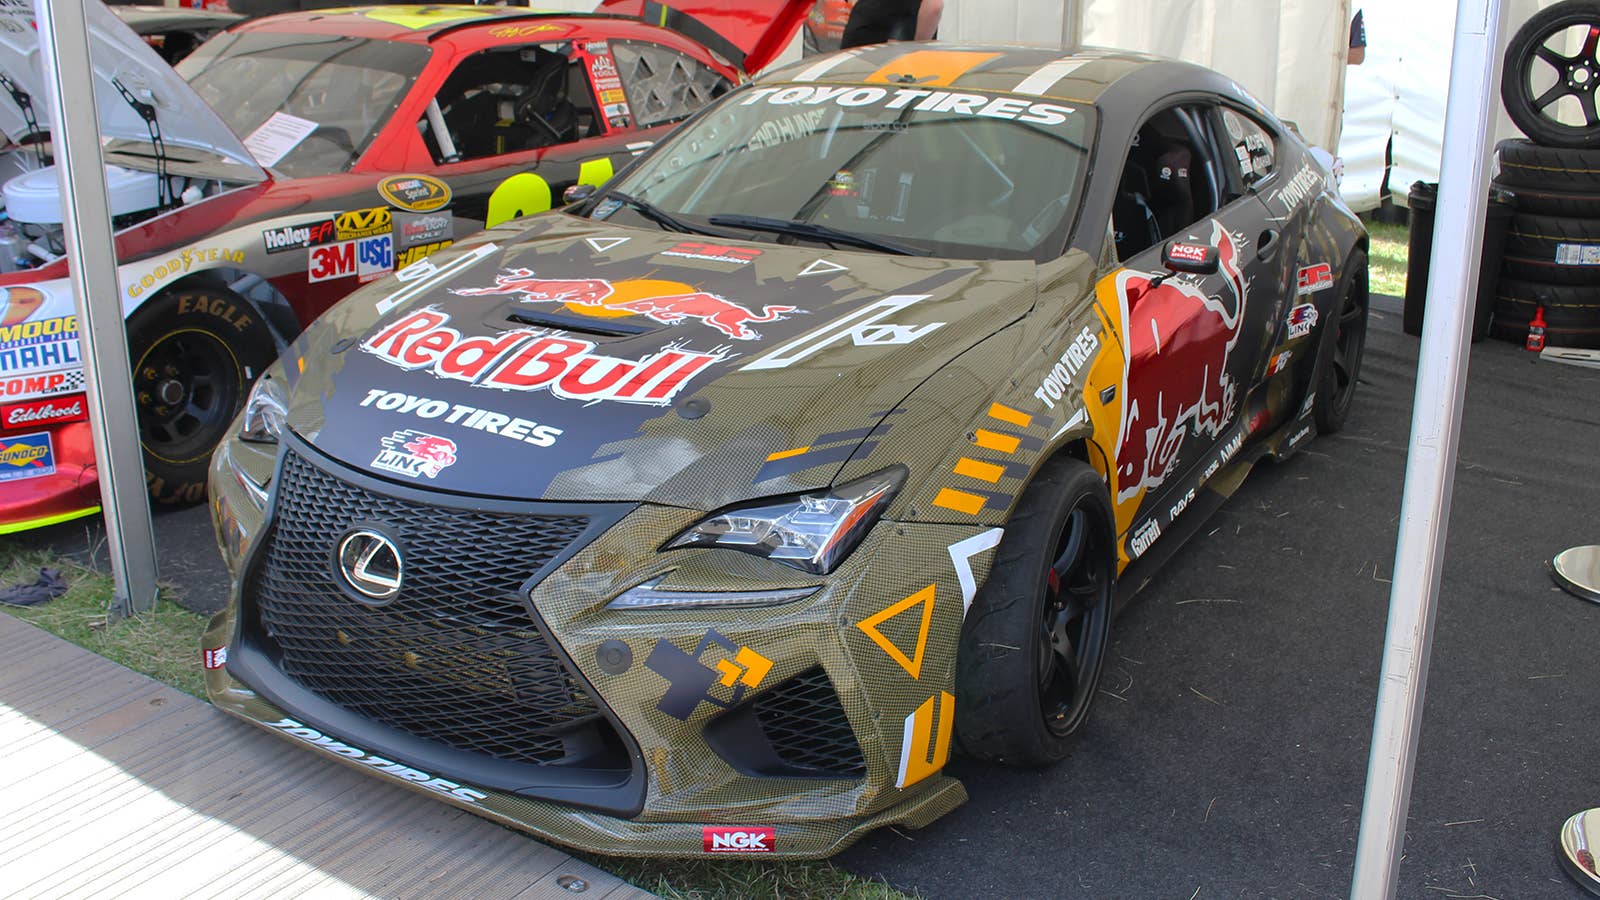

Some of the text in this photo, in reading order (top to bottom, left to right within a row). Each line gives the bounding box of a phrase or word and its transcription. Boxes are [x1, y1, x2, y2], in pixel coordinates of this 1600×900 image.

[739, 86, 1076, 125] TOYO TIRES
[263, 226, 310, 247] Holley
[359, 236, 391, 269] USG
[1172, 245, 1205, 257] NGK
[311, 242, 355, 279] 3M
[0, 315, 79, 343] MOOG
[177, 295, 253, 332] EAGLE
[360, 308, 724, 403] Red Bull
[1034, 326, 1098, 409] TOYO TIRES
[8, 401, 82, 424] Edelbrock
[360, 389, 564, 448] TOYO TIRES
[1170, 488, 1195, 521] RAYS
[1131, 518, 1161, 557] Garrett
[267, 718, 488, 802] TOYO TIRES
[713, 831, 767, 848] NGK
